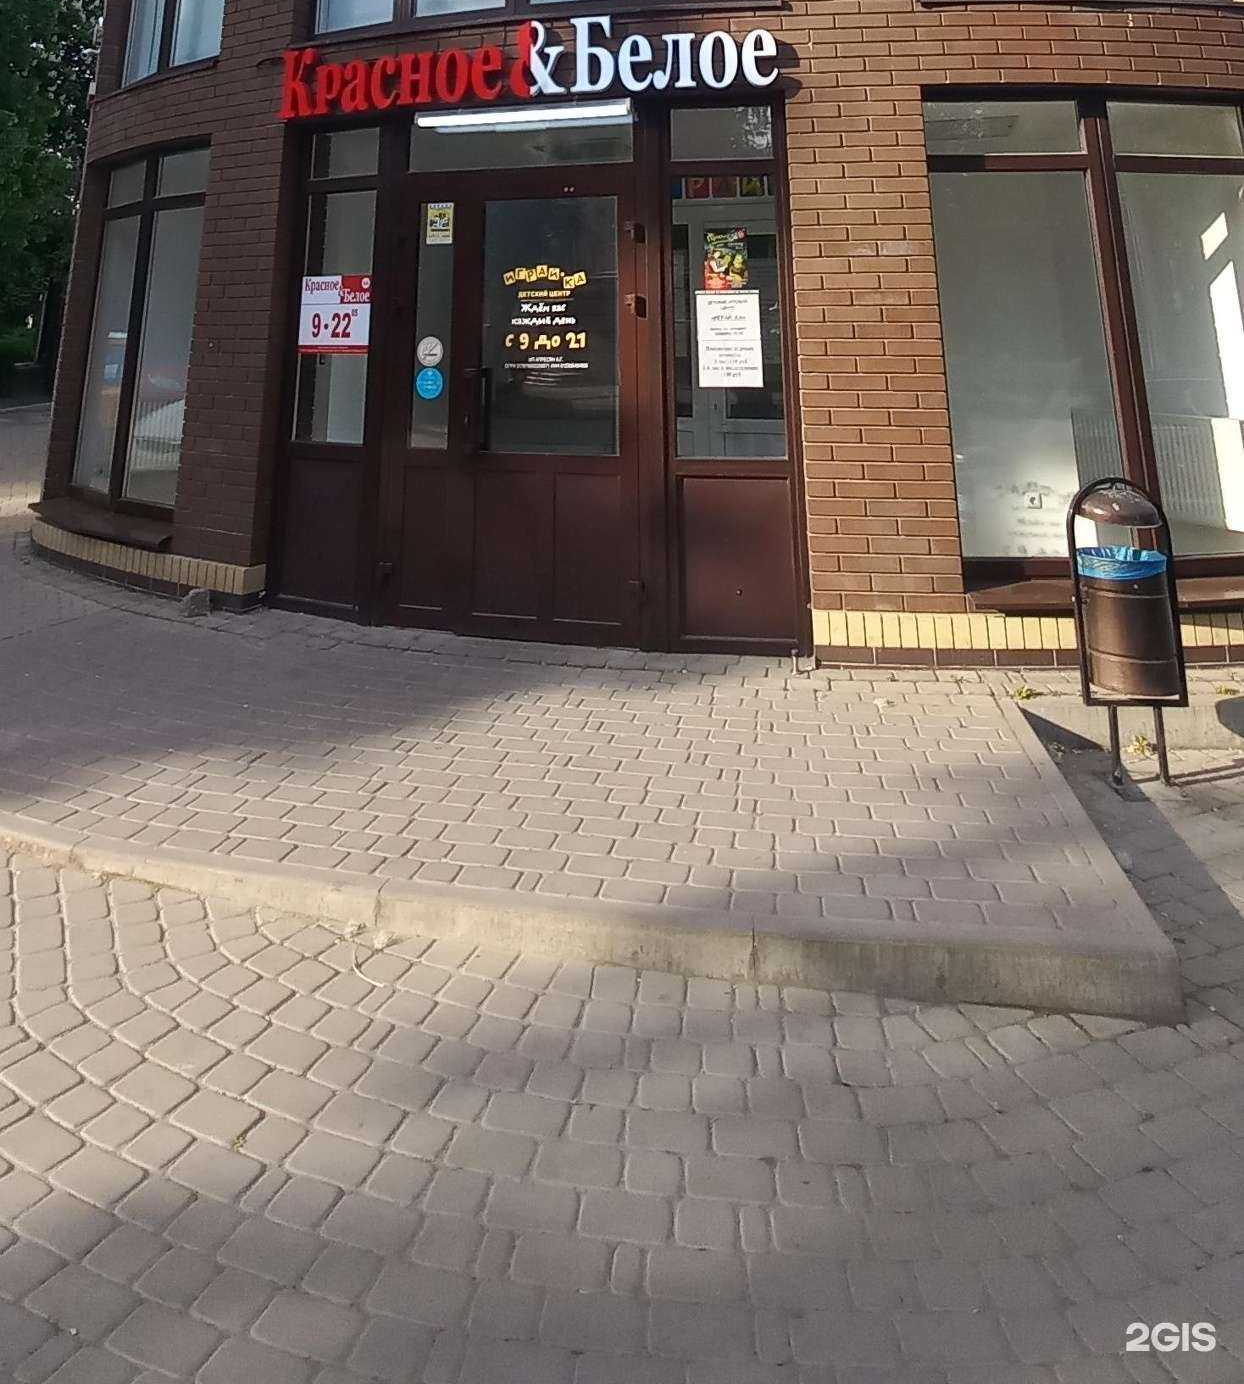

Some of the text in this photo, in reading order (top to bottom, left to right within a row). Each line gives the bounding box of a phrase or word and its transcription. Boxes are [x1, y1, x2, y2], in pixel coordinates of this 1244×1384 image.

[305, 278, 339, 294] Красное
[343, 288, 370, 303] Белое
[519, 332, 530, 350] 9
[565, 332, 586, 349] 21
